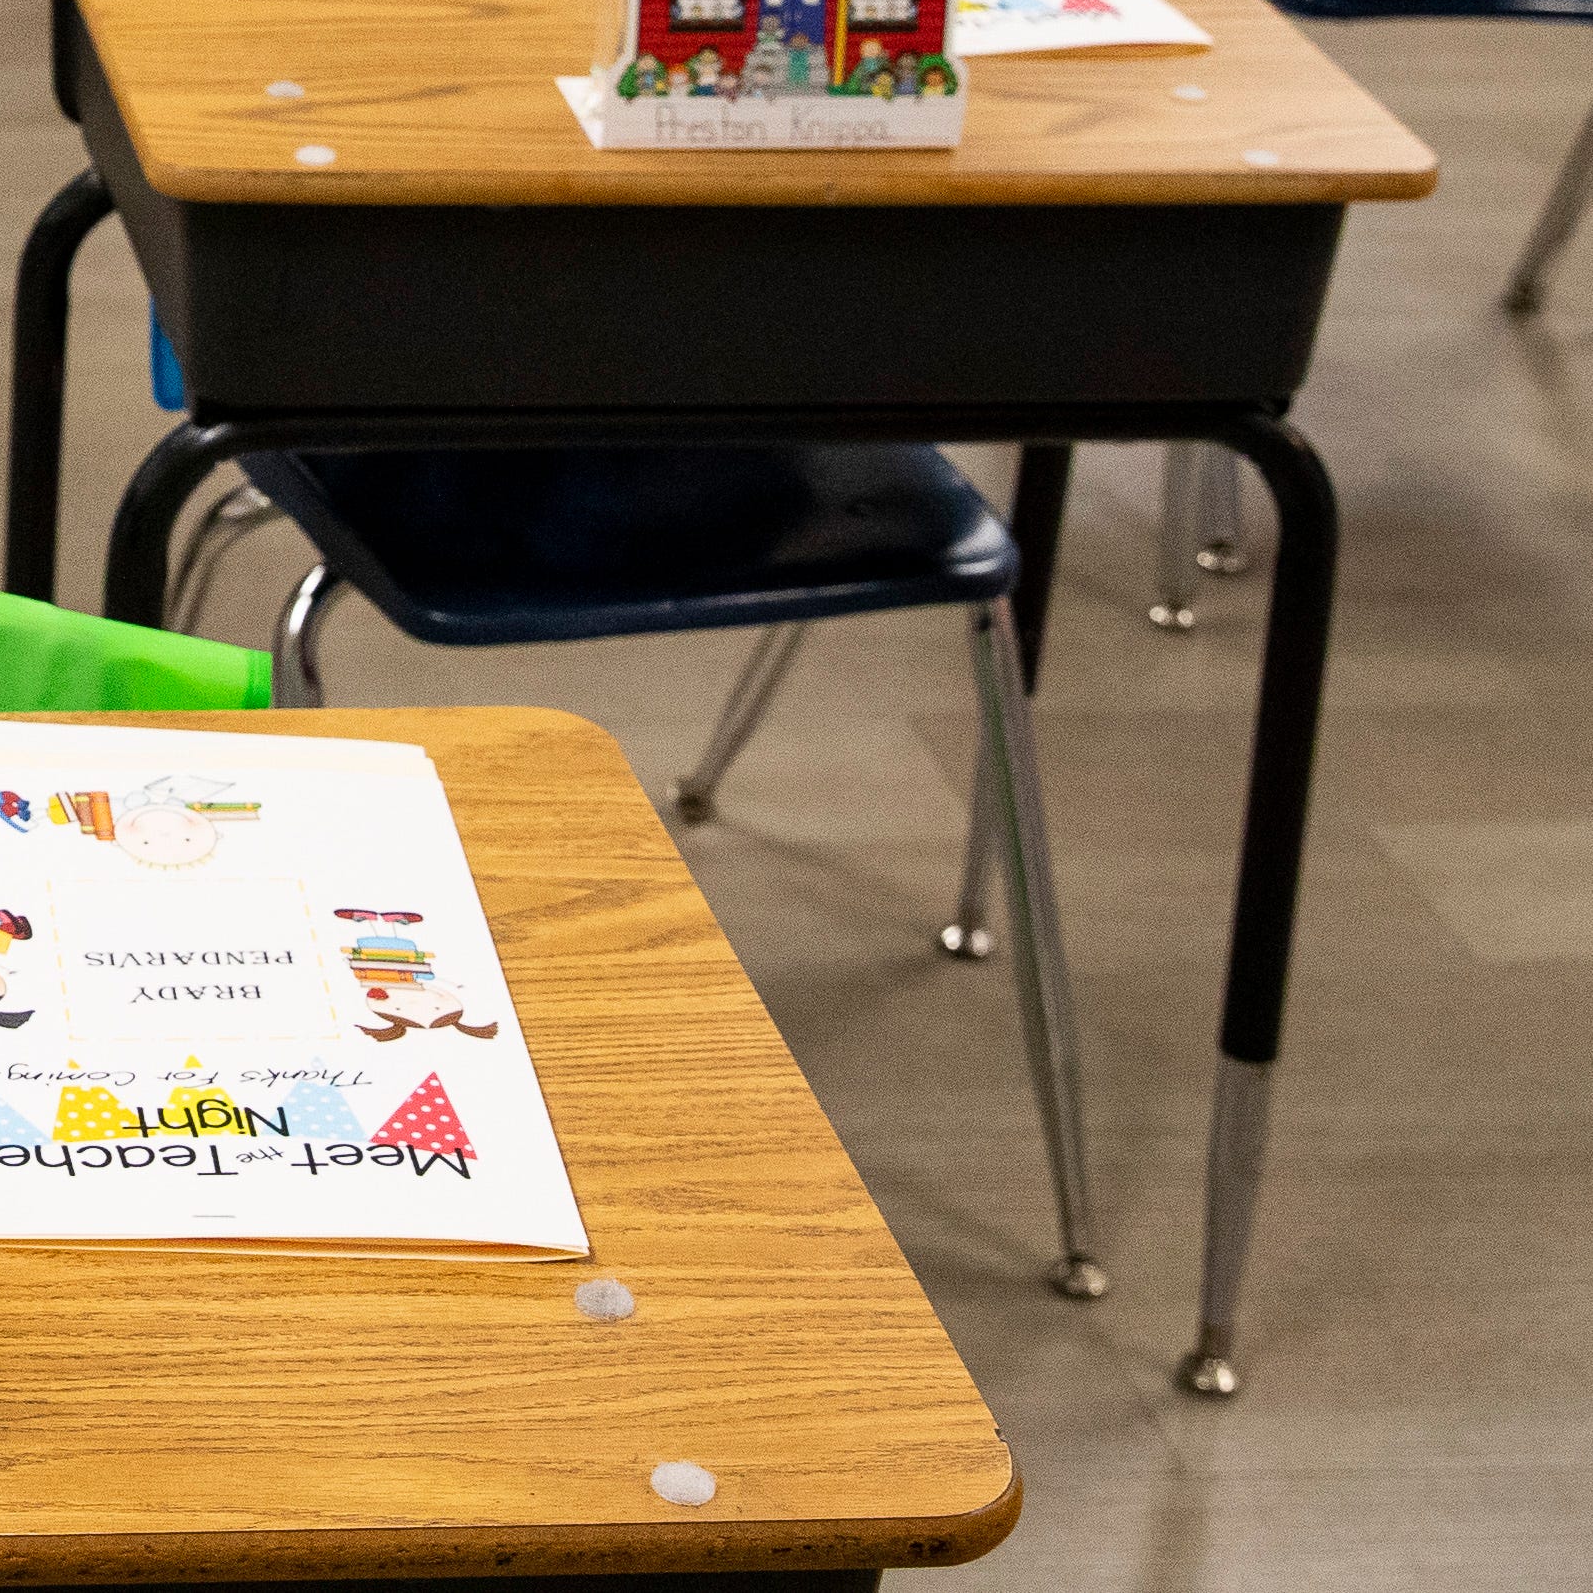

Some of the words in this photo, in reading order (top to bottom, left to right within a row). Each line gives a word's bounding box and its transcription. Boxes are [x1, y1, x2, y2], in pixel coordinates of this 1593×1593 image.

[83, 950, 294, 969] PENDARVIS
[130, 984, 262, 1004] BRADY
[157, 1069, 219, 1086] For
[240, 1068, 373, 1088] Thanks
[122, 1098, 290, 1138] Night
[236, 1145, 285, 1165] the
[291, 1143, 472, 1180] Meet
